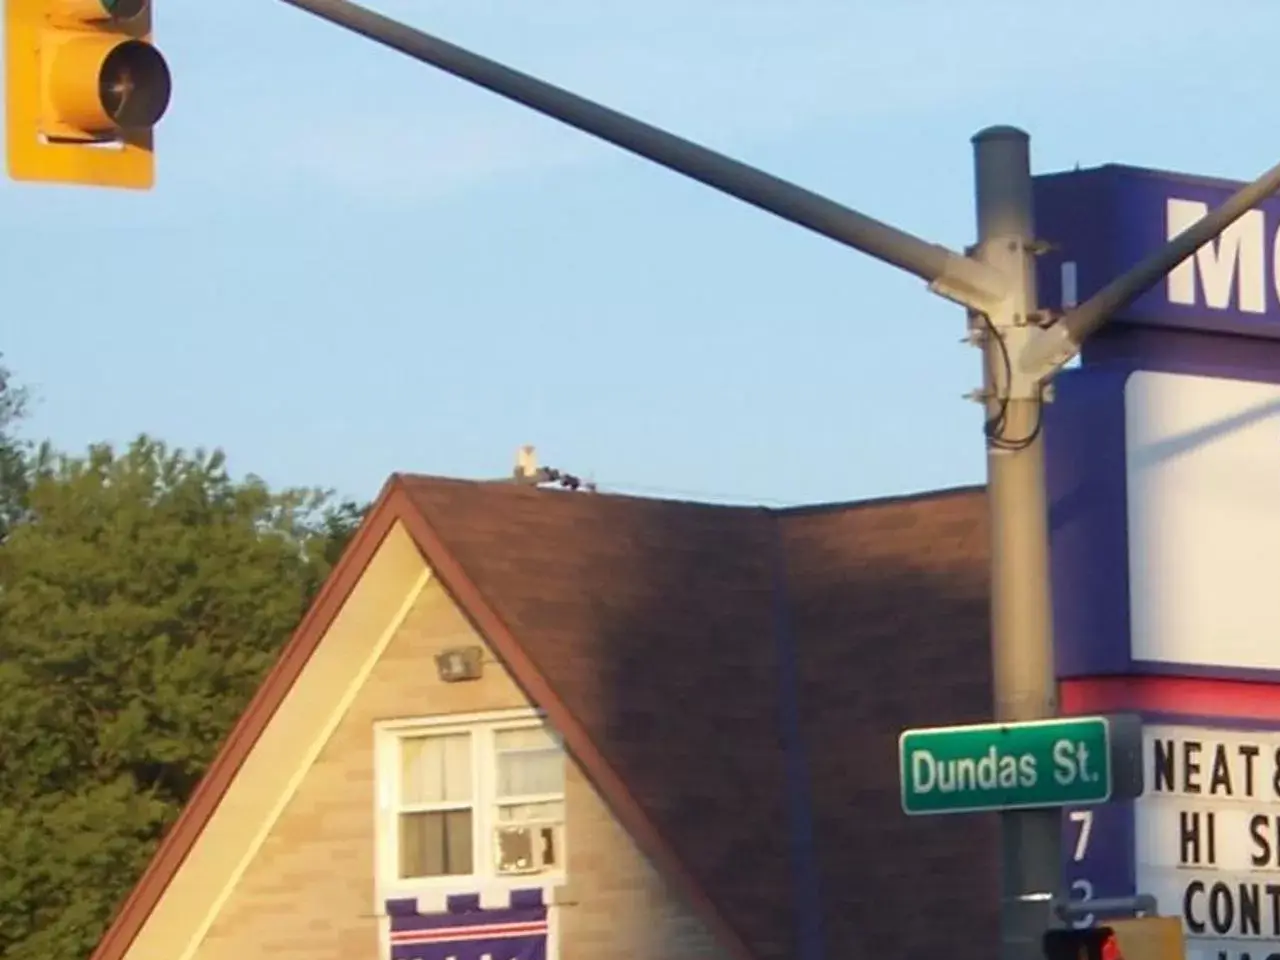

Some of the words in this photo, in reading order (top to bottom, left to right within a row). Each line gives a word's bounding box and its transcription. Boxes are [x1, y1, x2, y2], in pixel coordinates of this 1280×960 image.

[911, 745, 1036, 793] Dundas
[1053, 739, 1099, 785] St.
[1180, 811, 1215, 864] HI
